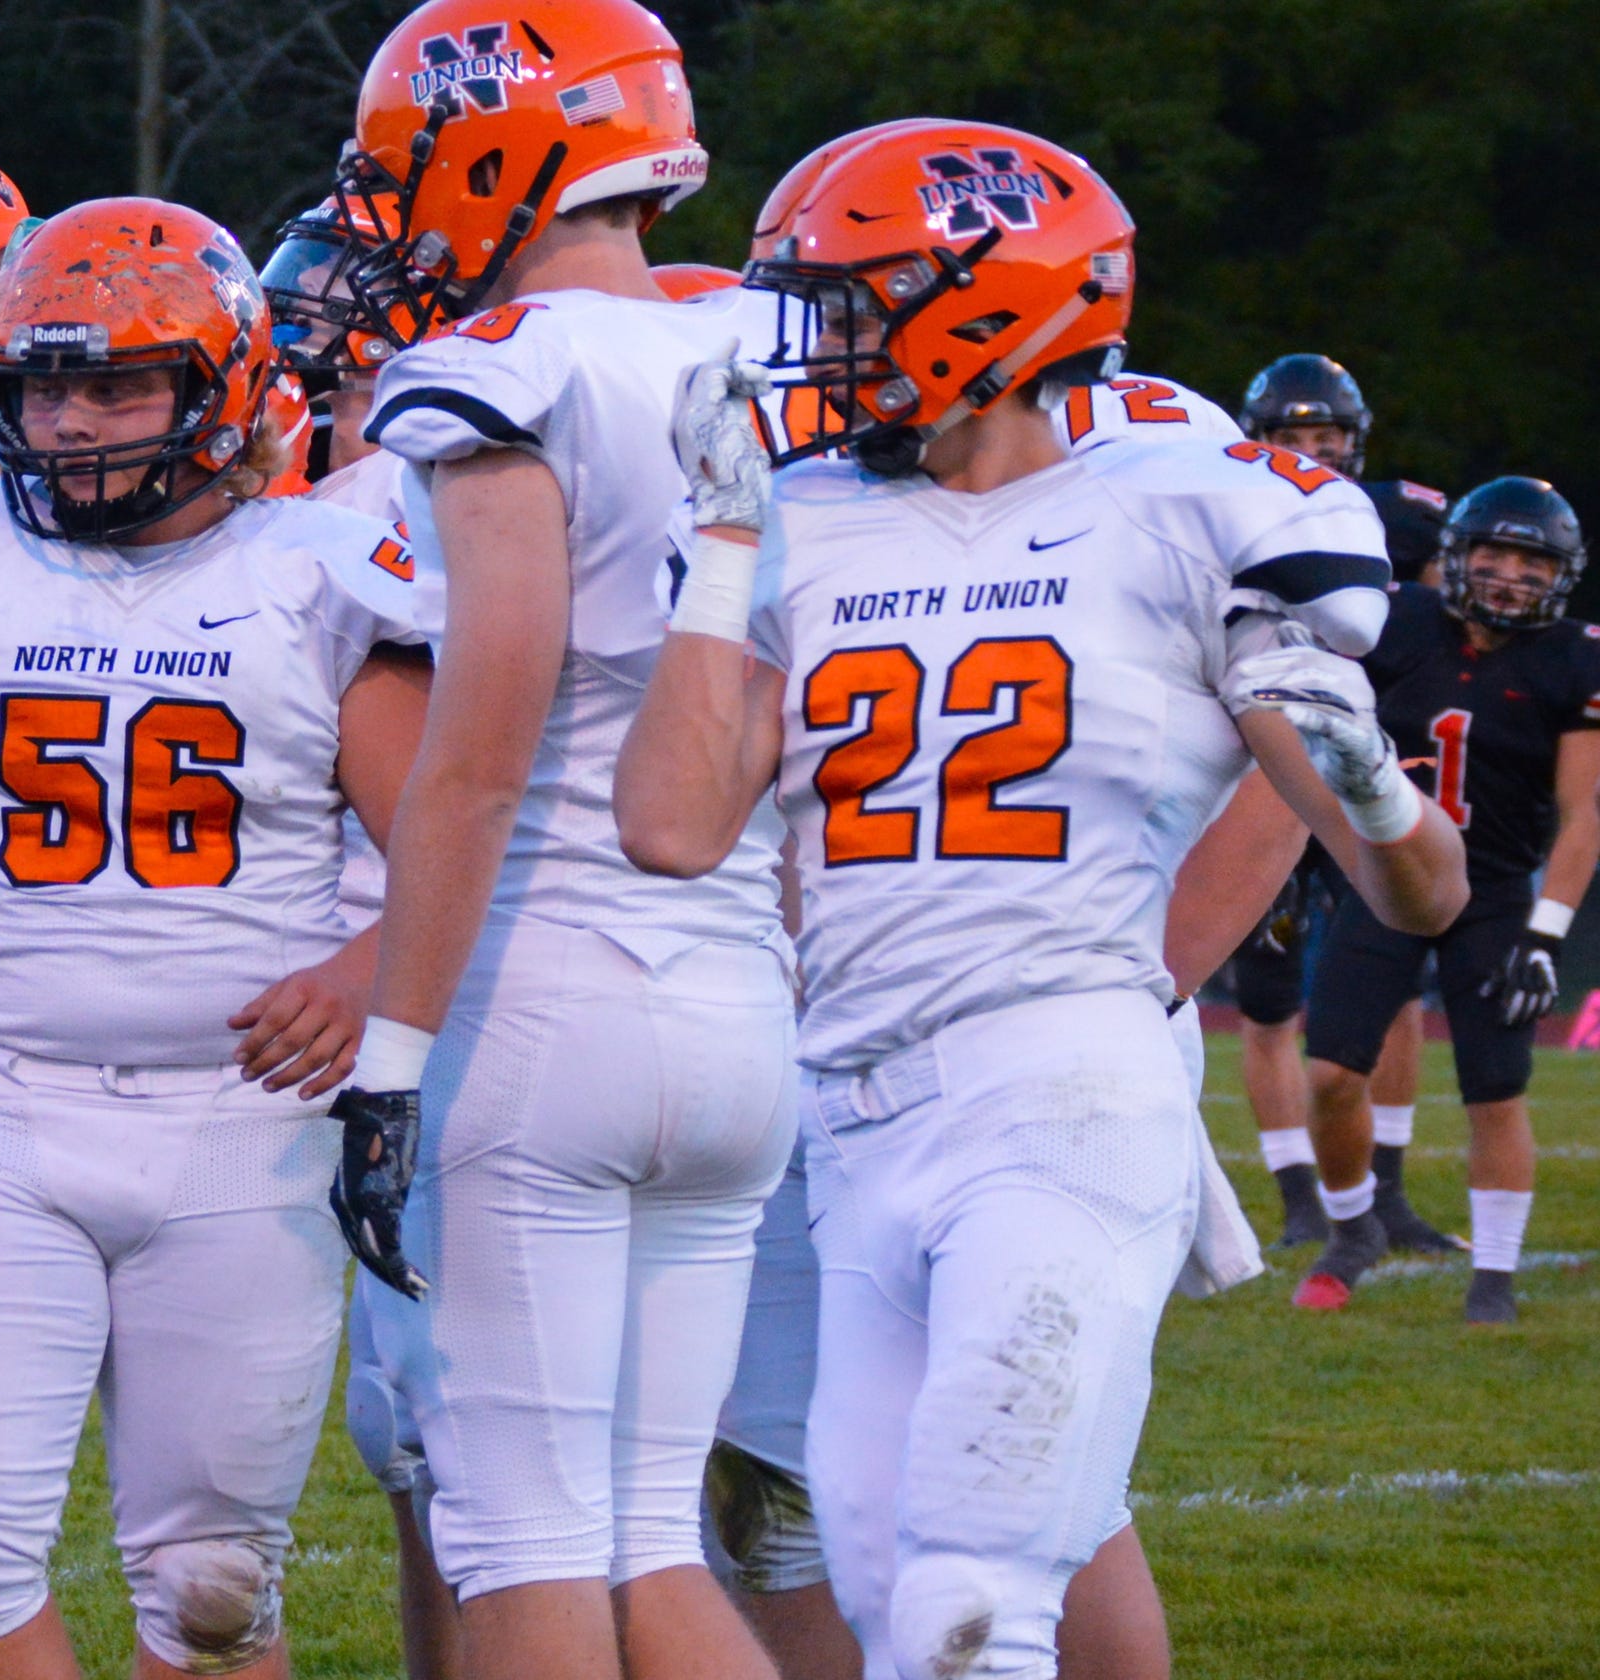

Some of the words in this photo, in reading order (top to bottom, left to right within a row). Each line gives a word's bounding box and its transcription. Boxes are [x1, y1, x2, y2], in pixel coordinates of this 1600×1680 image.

[410, 50, 522, 106] UNION
[916, 173, 1049, 215] UNION
[34, 326, 87, 342] Riddell
[832, 586, 947, 626] NORTH
[962, 577, 1069, 613] UNION
[13, 645, 119, 673] NORTH
[133, 650, 232, 677] UNION
[802, 634, 1075, 869] 22
